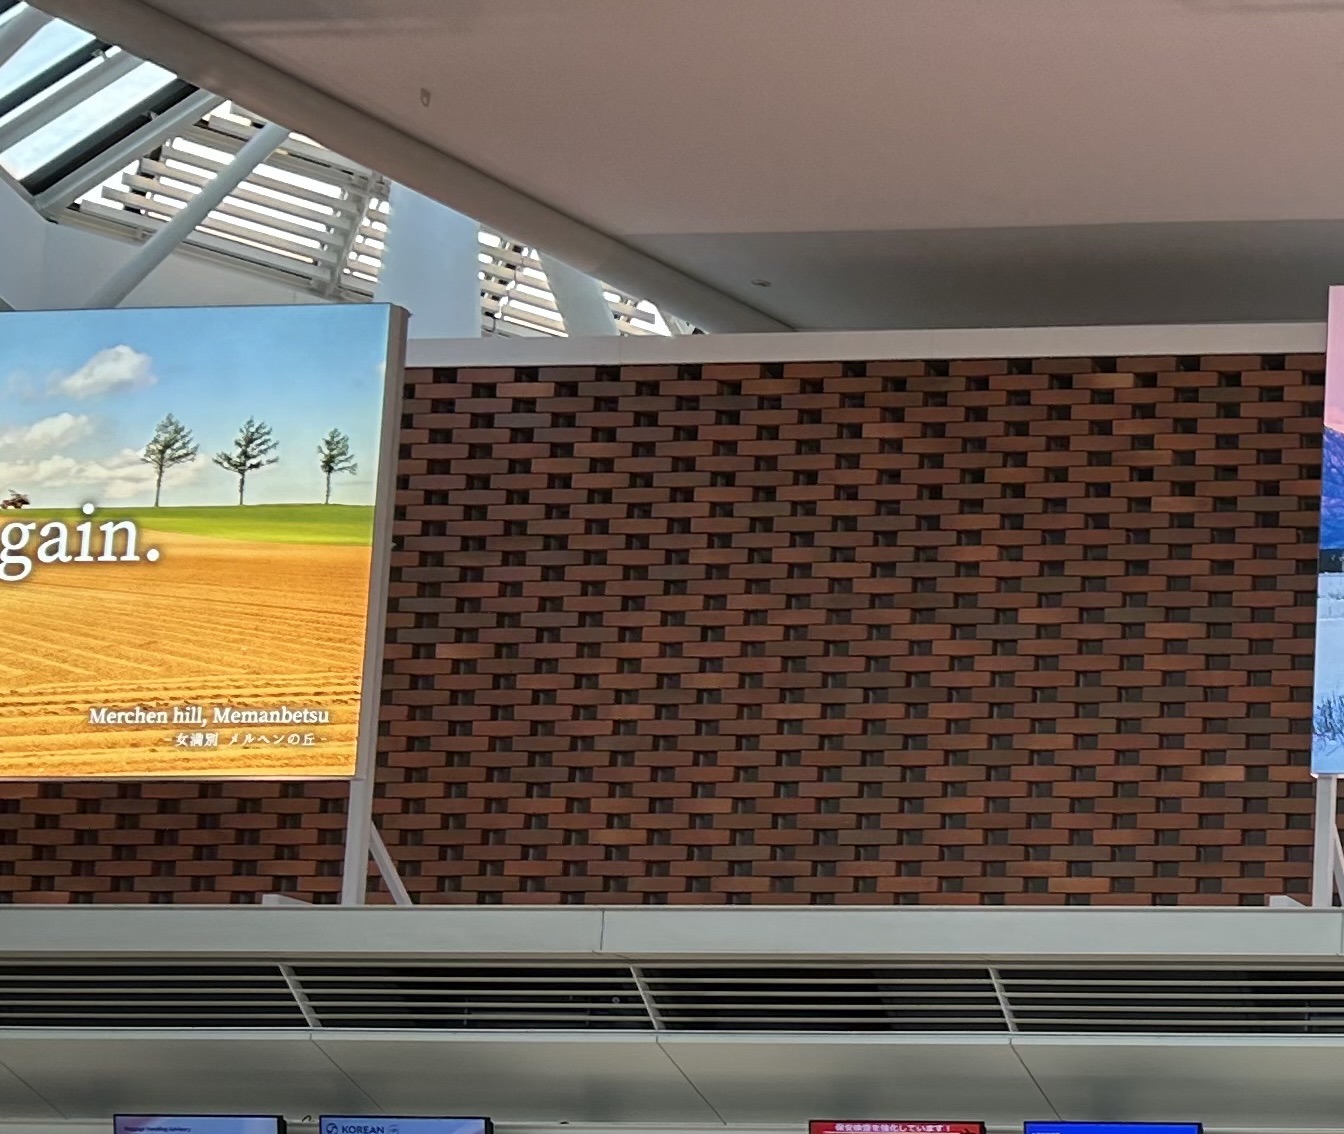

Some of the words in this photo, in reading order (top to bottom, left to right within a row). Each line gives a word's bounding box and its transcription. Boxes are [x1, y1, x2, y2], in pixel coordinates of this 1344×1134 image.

[88, 707, 168, 724] Merchen
[172, 706, 208, 727] hill,
[212, 706, 330, 724] Memanbetsu
[341, 1125, 385, 1134] KOREAN
